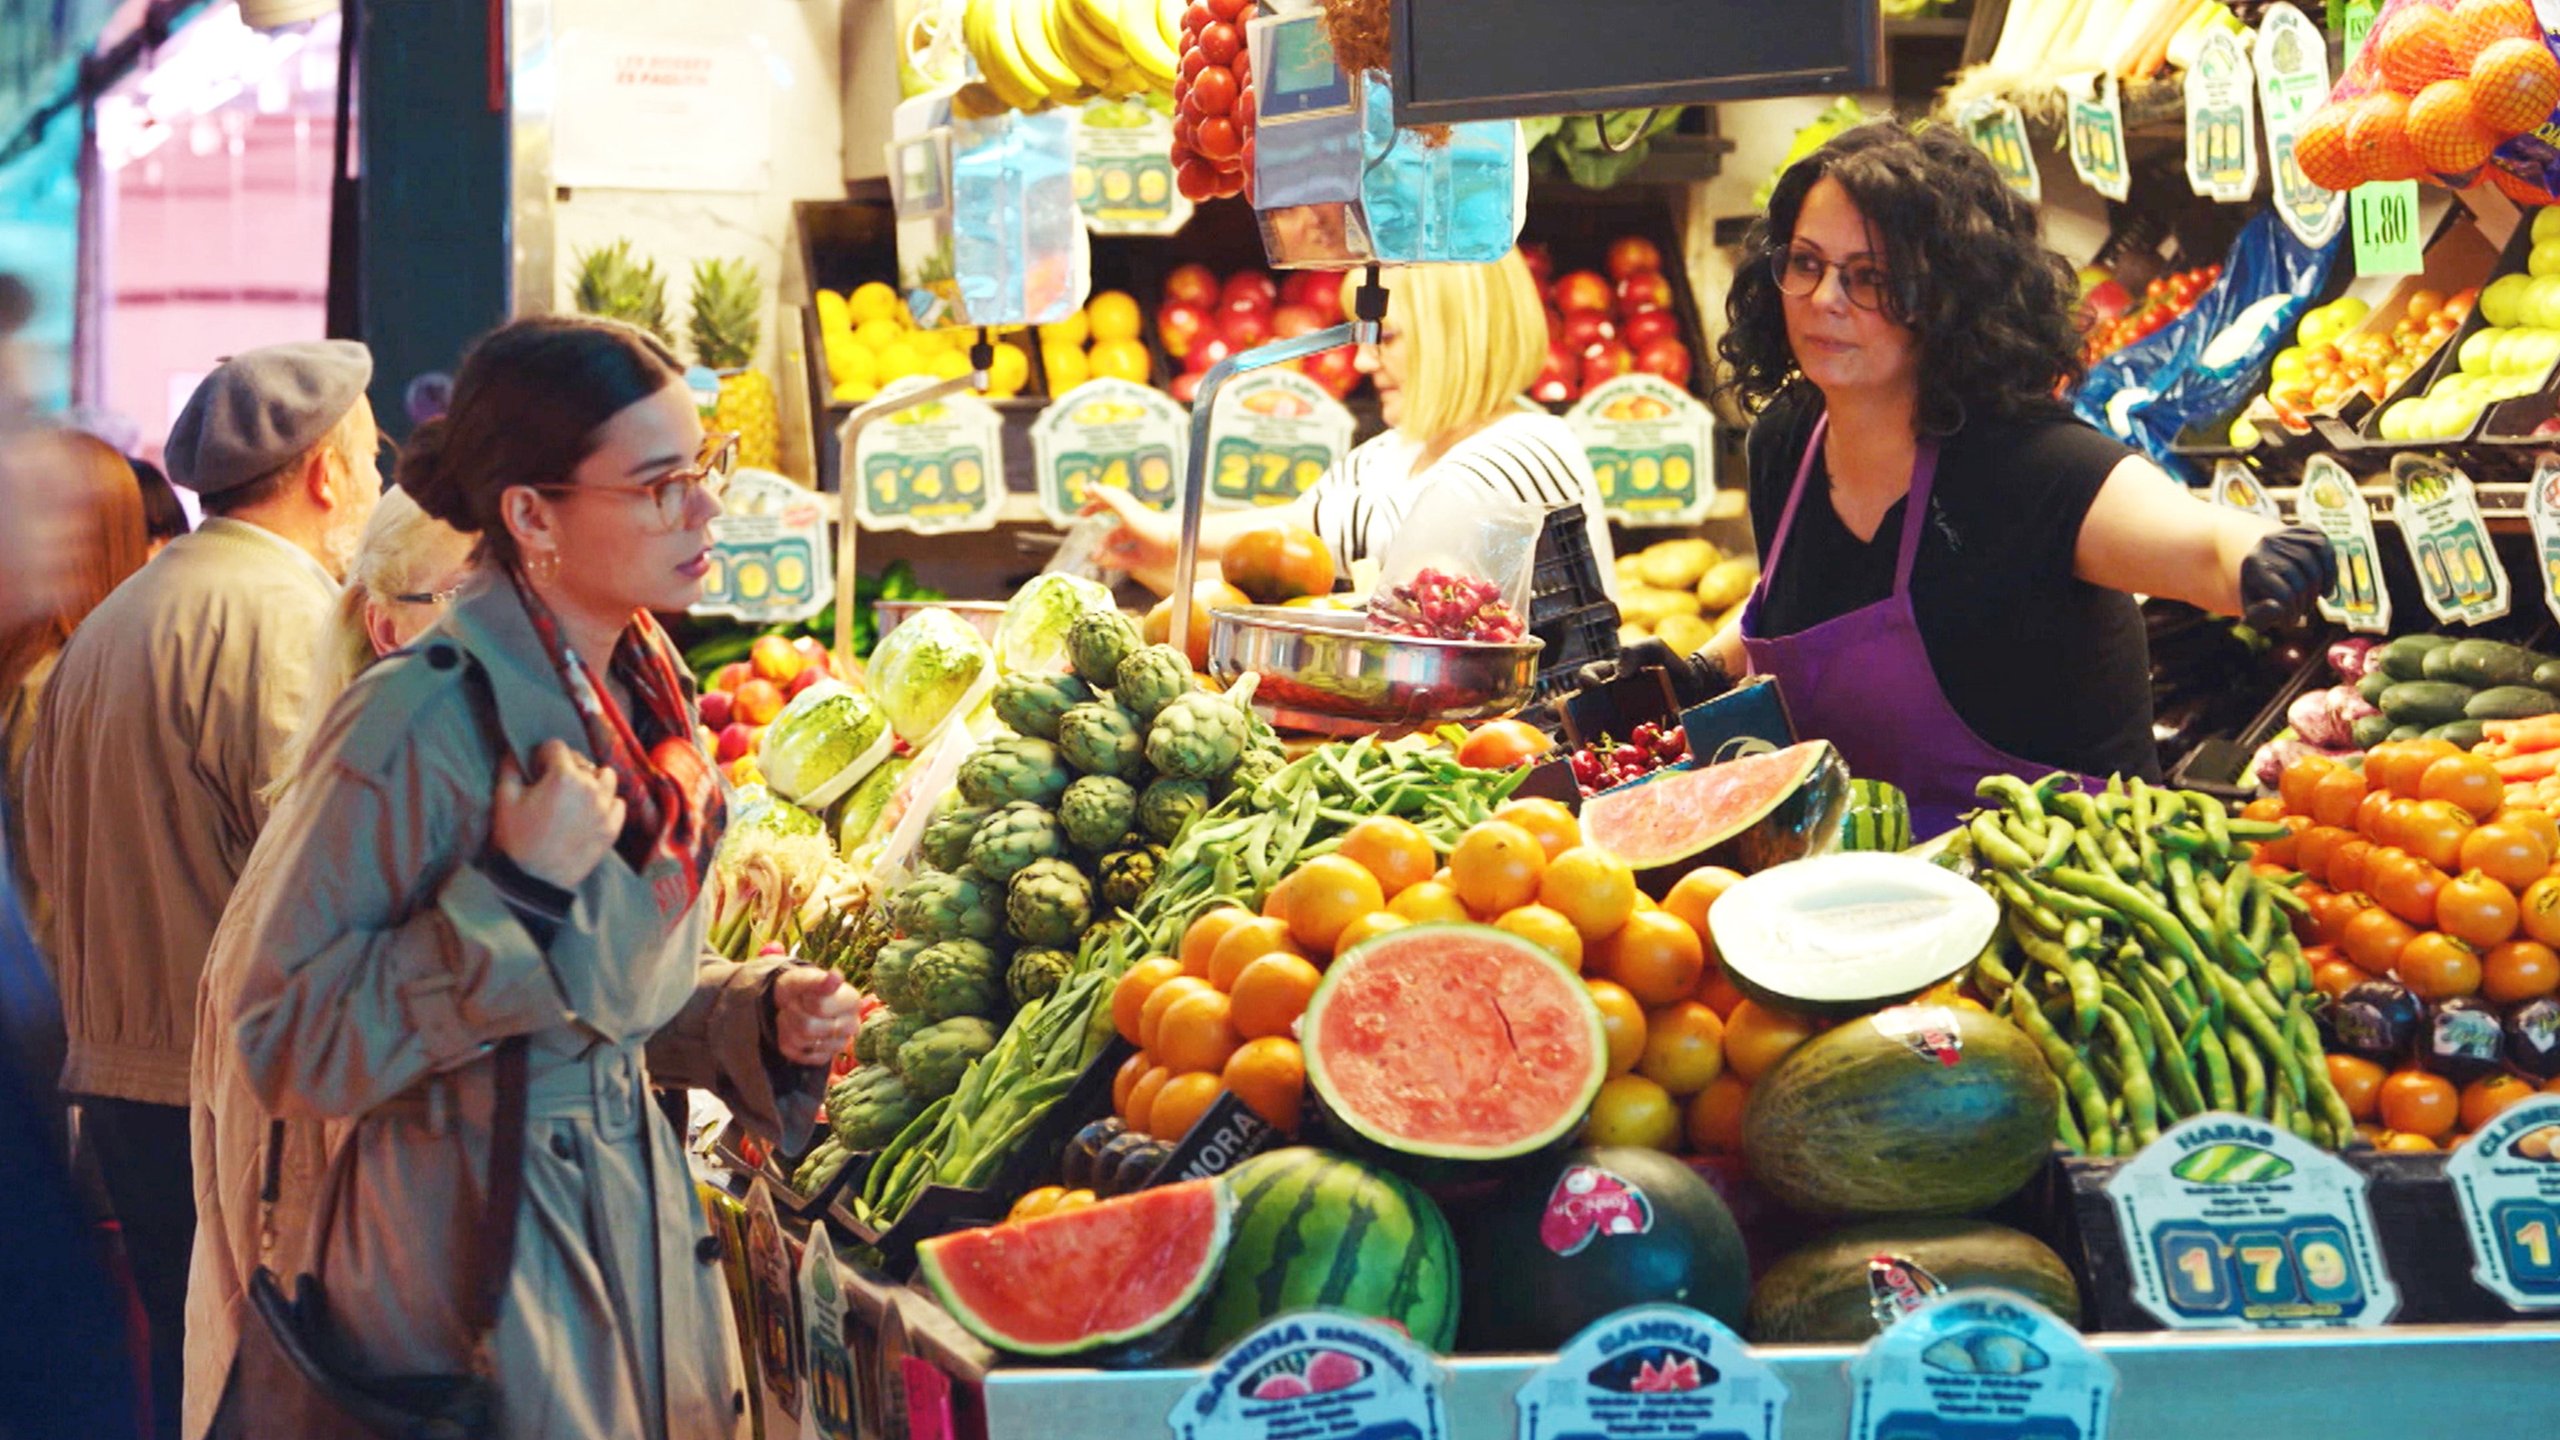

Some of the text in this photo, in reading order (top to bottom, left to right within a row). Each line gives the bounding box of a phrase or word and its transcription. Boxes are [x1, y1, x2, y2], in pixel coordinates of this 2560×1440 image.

[2361, 195, 2408, 252] 1,80
[2174, 1123, 2275, 1151] HABAS
[2177, 1240, 2348, 1294] 1'79
[1596, 1320, 1712, 1356] SANDIA
[1194, 1323, 1308, 1417] SANDIA
